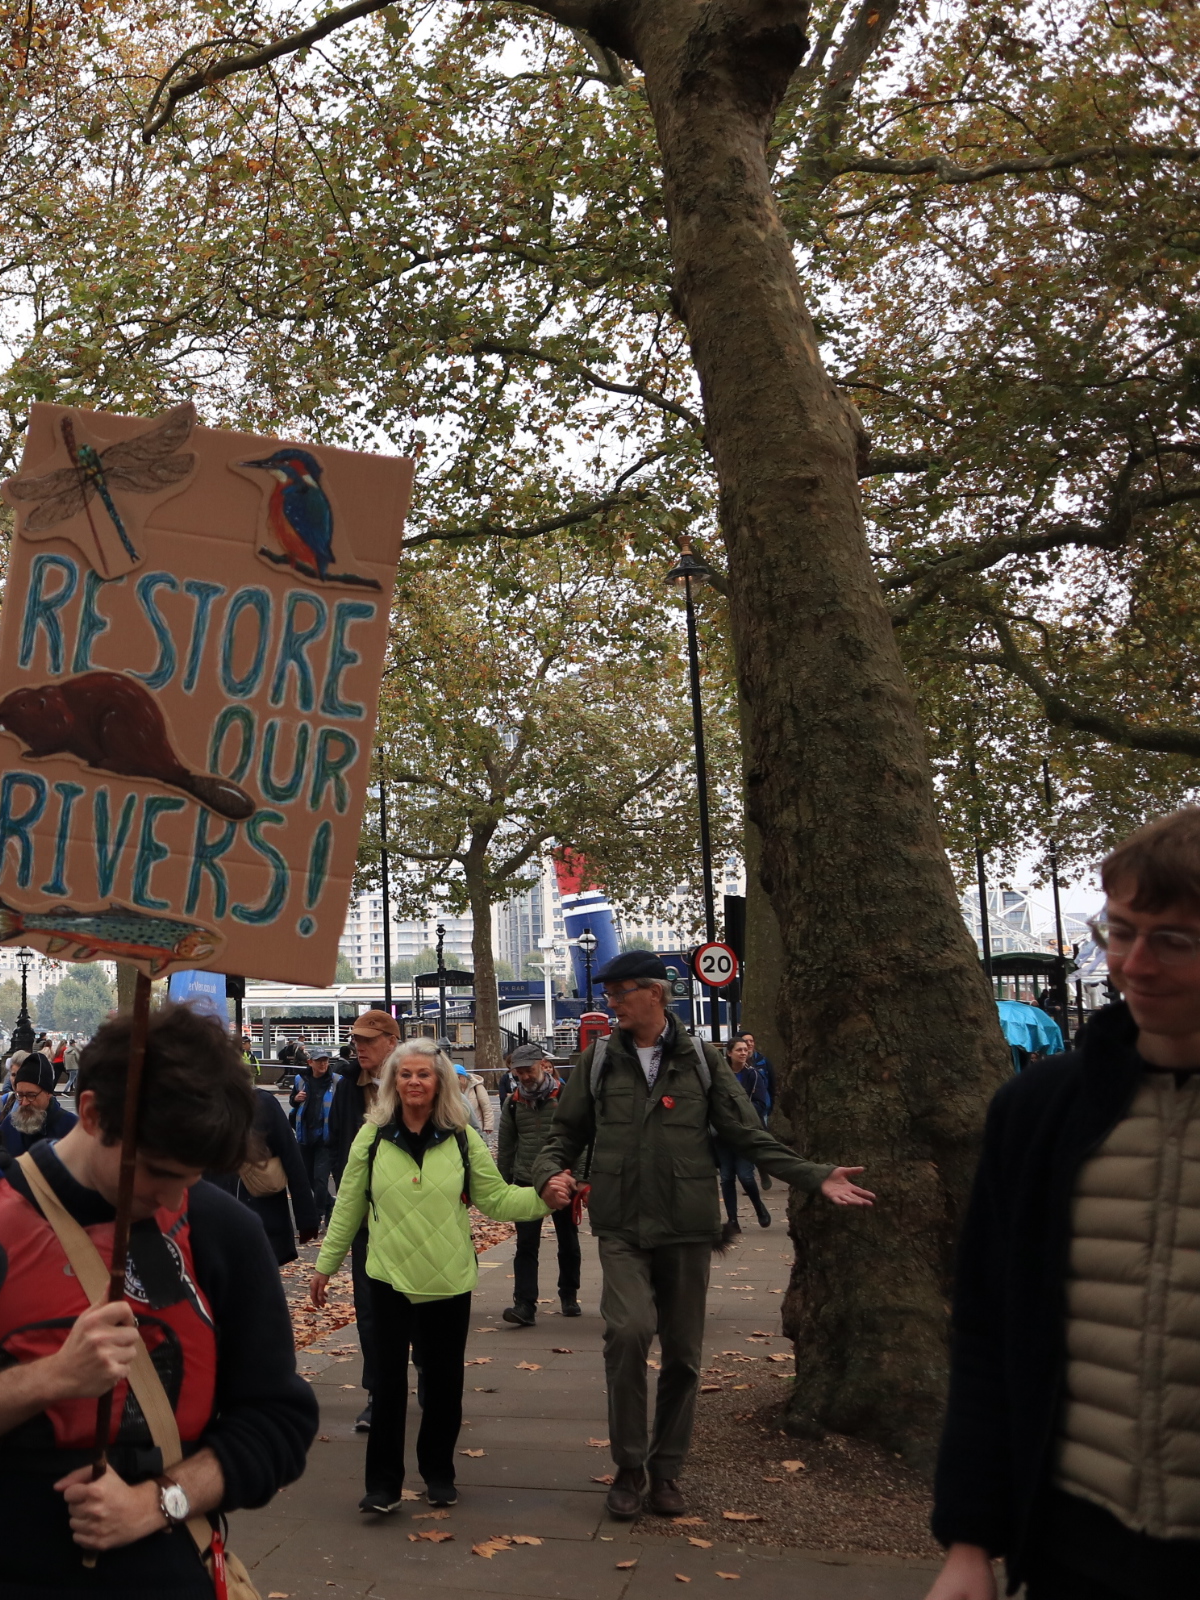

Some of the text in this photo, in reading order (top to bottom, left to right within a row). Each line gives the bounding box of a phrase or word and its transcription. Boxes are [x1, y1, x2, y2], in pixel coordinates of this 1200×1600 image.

[18, 554, 376, 717] RESTORE
[209, 705, 358, 813] OUR
[702, 955, 731, 973] 20
